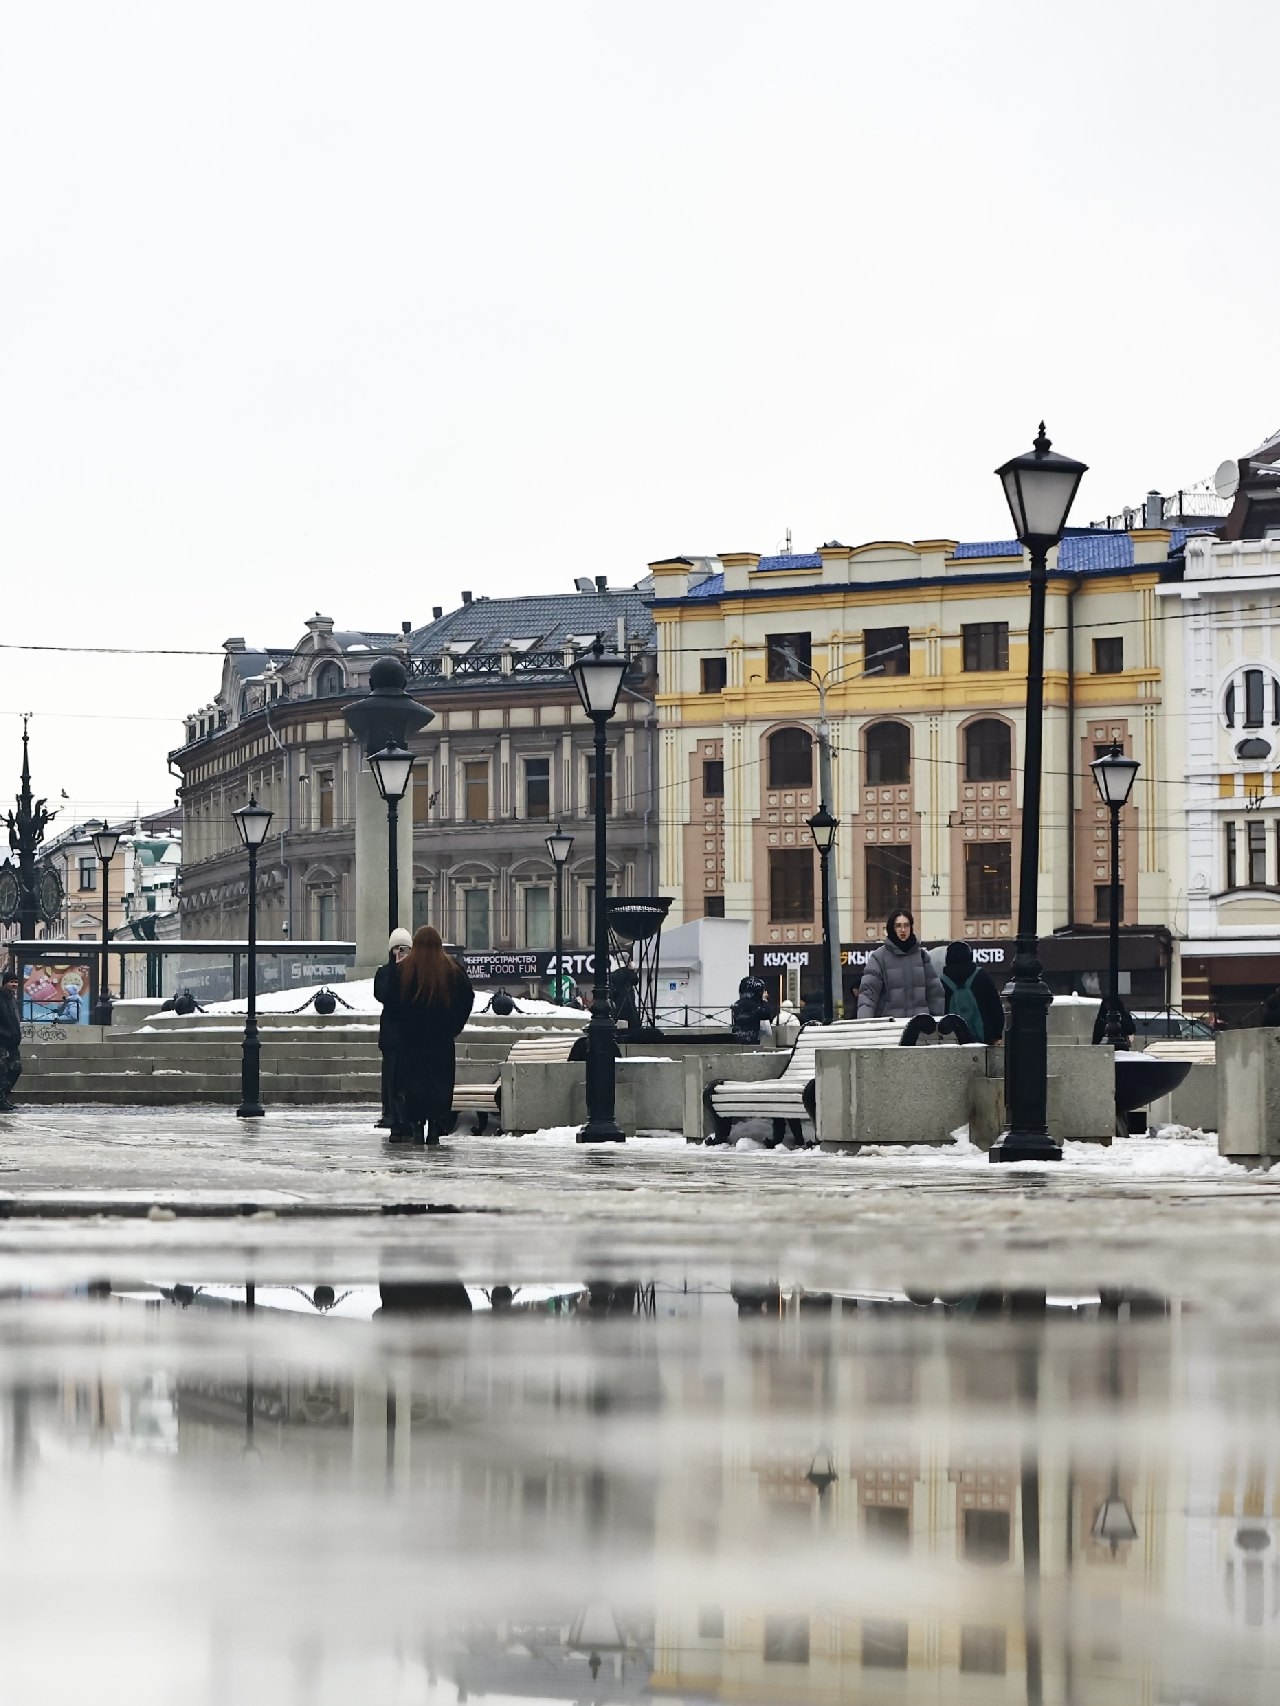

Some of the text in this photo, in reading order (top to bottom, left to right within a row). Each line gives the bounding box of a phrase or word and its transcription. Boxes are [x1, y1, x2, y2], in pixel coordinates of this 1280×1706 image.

[463, 955, 537, 964] ИБЕРПРОСТРАНСТВО
[763, 951, 809, 967] КУХНЯ
[972, 948, 1005, 964] KSTB
[466, 965, 487, 975] AME.
[519, 964, 537, 973] FUN
